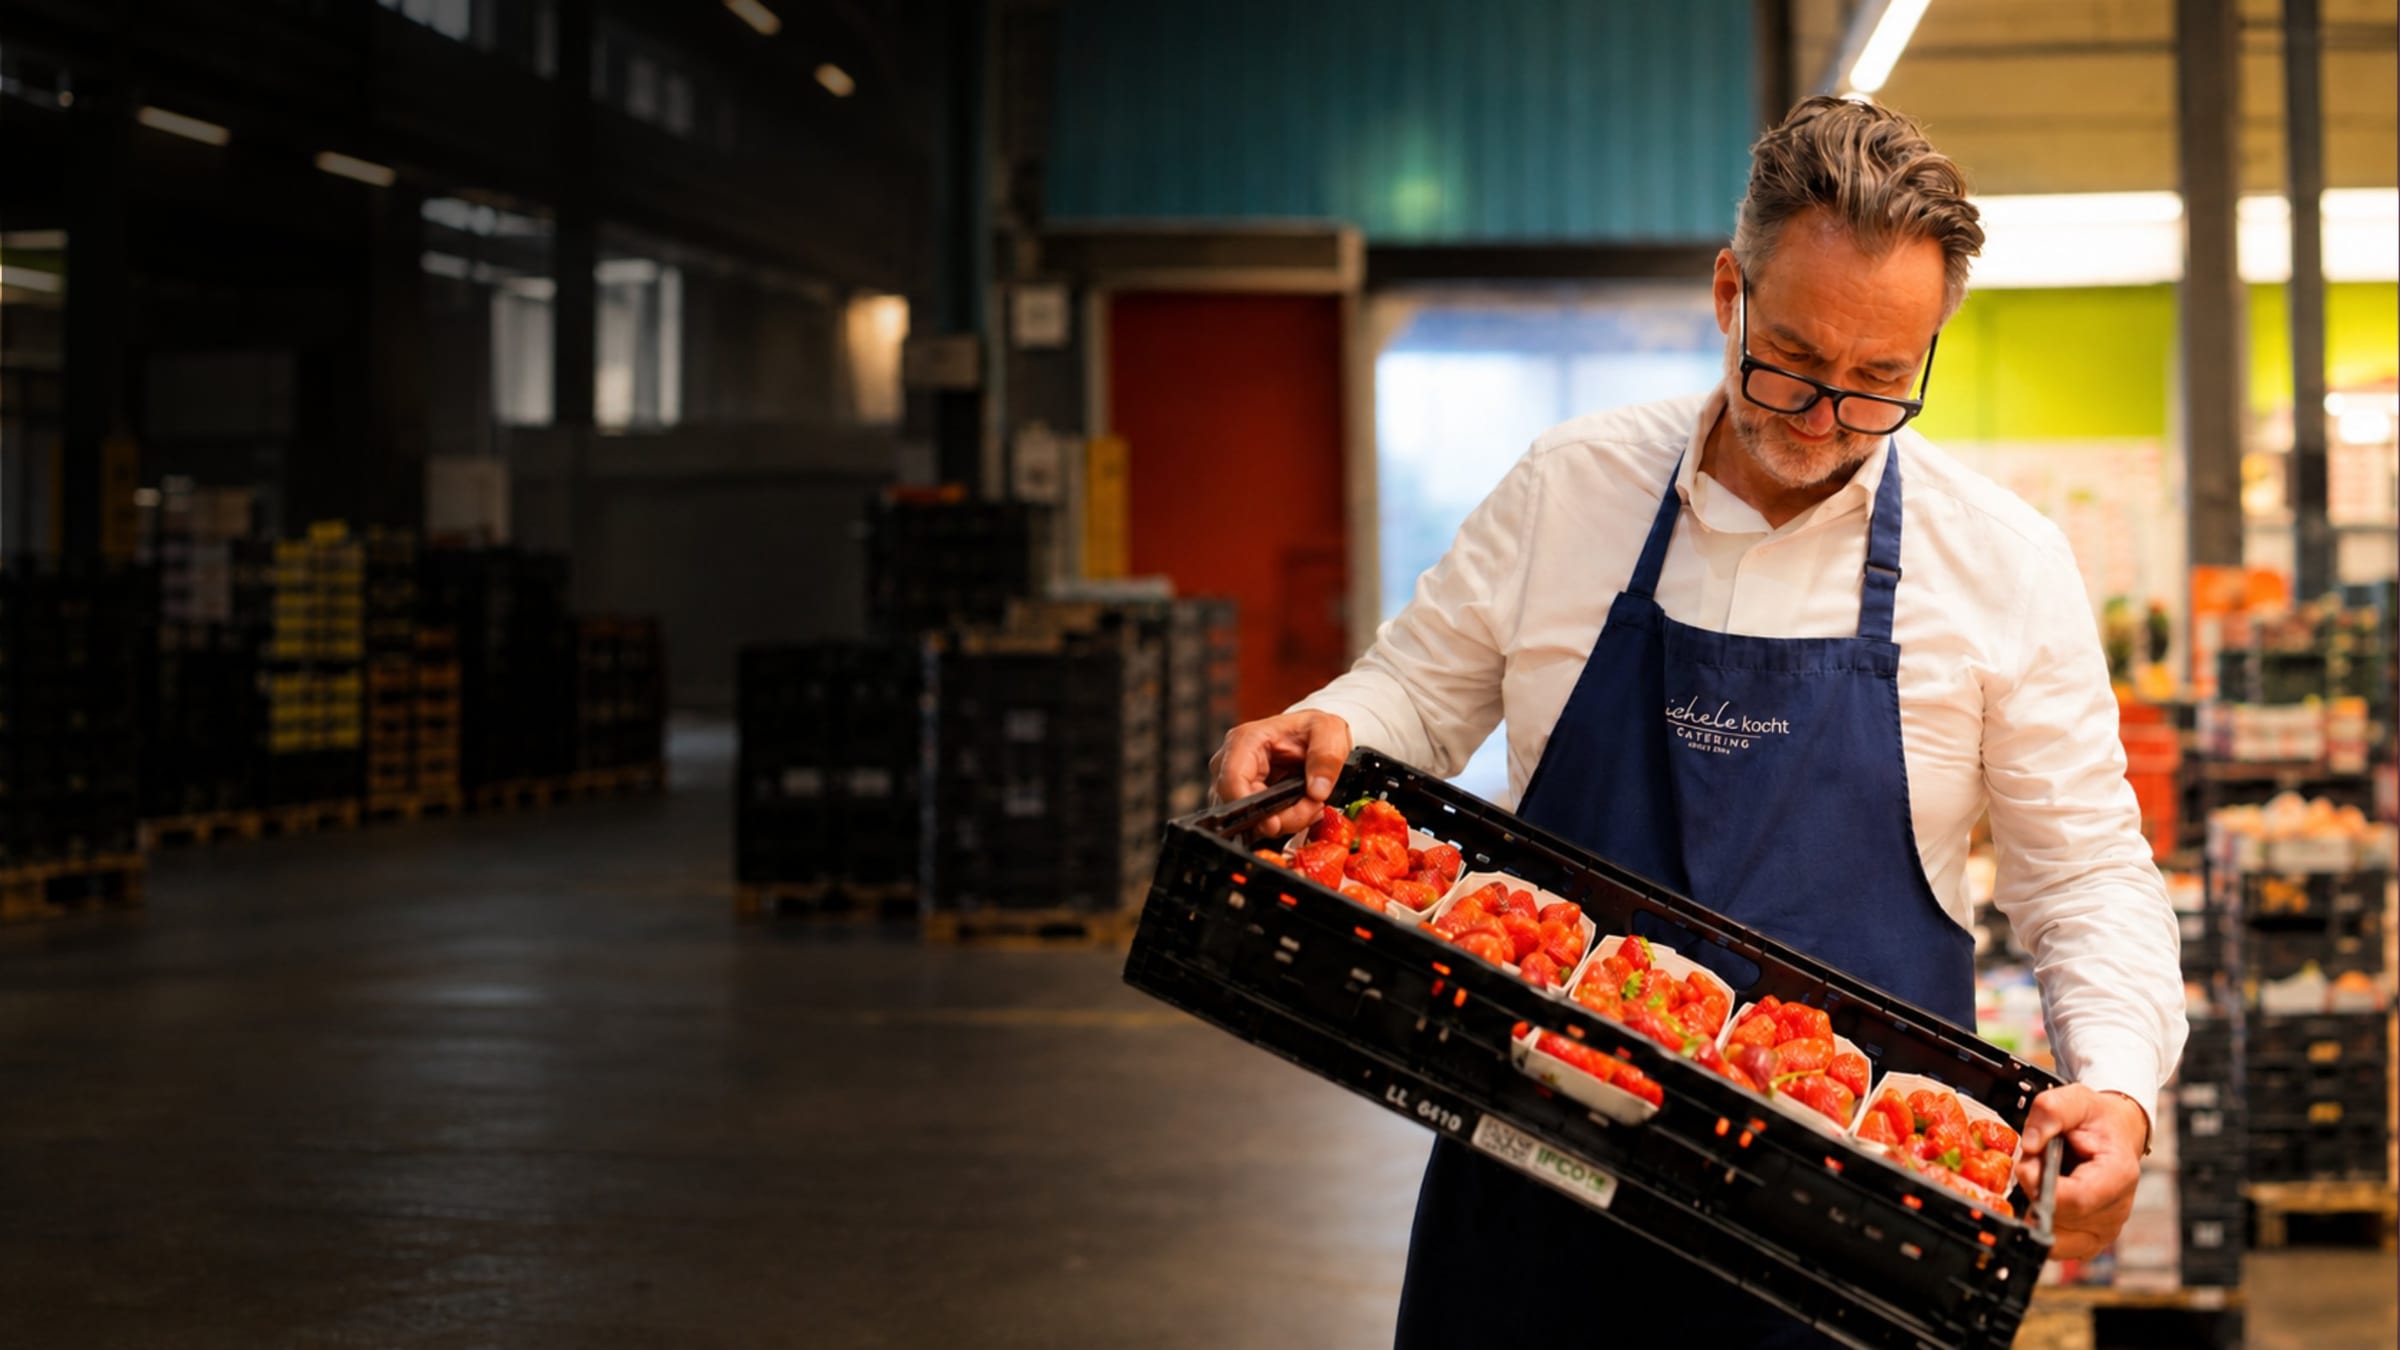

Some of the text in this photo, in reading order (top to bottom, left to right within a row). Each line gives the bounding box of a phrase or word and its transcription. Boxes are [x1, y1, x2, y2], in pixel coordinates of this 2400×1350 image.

[1664, 695, 1790, 734] ichele kocht
[1676, 727, 1750, 749] CATERING
